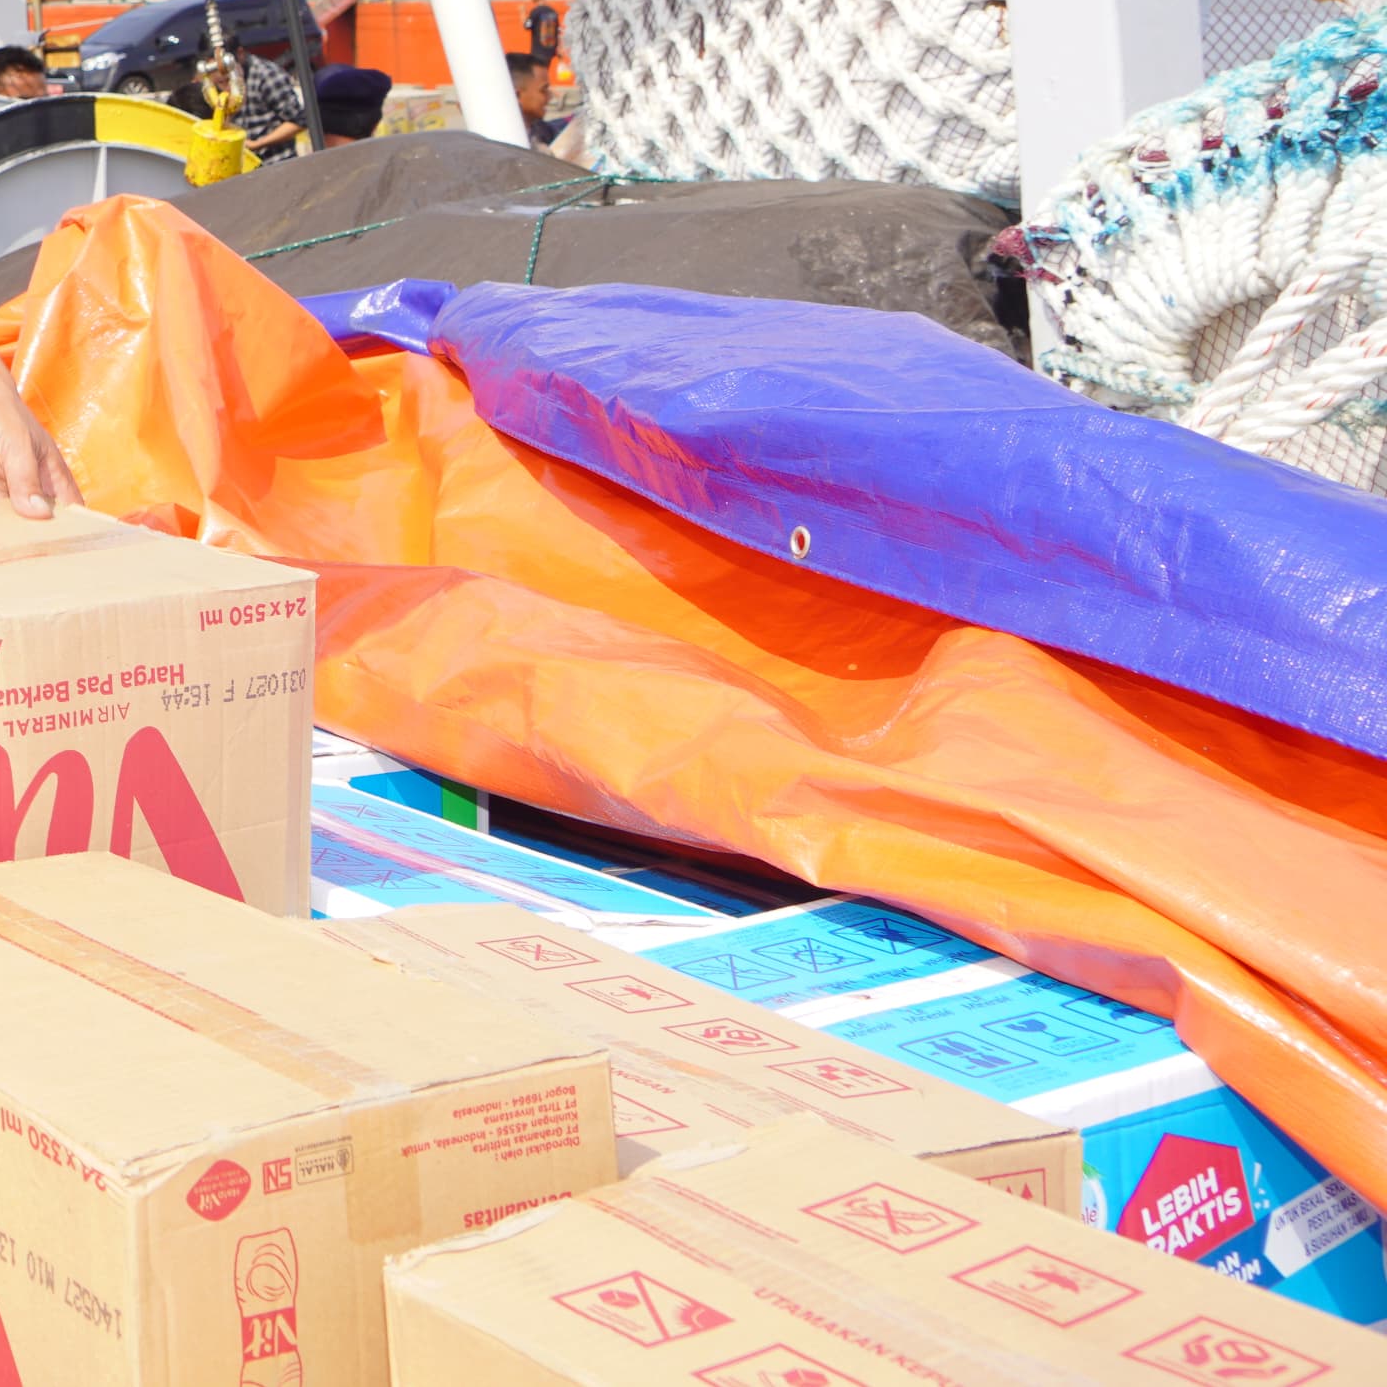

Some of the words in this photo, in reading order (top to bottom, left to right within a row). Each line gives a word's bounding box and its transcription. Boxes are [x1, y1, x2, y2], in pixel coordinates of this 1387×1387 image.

[230, 604, 265, 627] 550
[285, 596, 307, 620] 24
[199, 609, 223, 631] ml
[77, 672, 113, 697] Pas
[120, 663, 185, 691] Harga
[245, 667, 307, 700] 031027
[160, 683, 211, 712] 16:44
[222, 679, 235, 702] F
[3, 707, 94, 738] MINERAL
[97, 701, 130, 726] AIR
[545, 1083, 577, 1101] Bogor
[452, 1100, 502, 1119] Indonesia
[483, 1105, 535, 1126] Investama
[539, 1100, 563, 1115] Tirta
[566, 1098, 578, 1110] PT
[0, 1107, 23, 1138] ml
[531, 1109, 579, 1130] Kuningan
[566, 1124, 579, 1136] PT
[28, 1125, 62, 1165] 330
[434, 1127, 486, 1148] Indonesia,
[513, 1124, 564, 1145] Grahamas
[401, 1140, 431, 1158] untuk
[501, 1146, 524, 1162] oleh
[526, 1135, 581, 1158] Diproduksi
[299, 1160, 335, 1178] HALAL
[1141, 1167, 1219, 1235] LEBIH
[1146, 1187, 1242, 1255] RAKTIS
[244, 1313, 298, 1360] Vit
